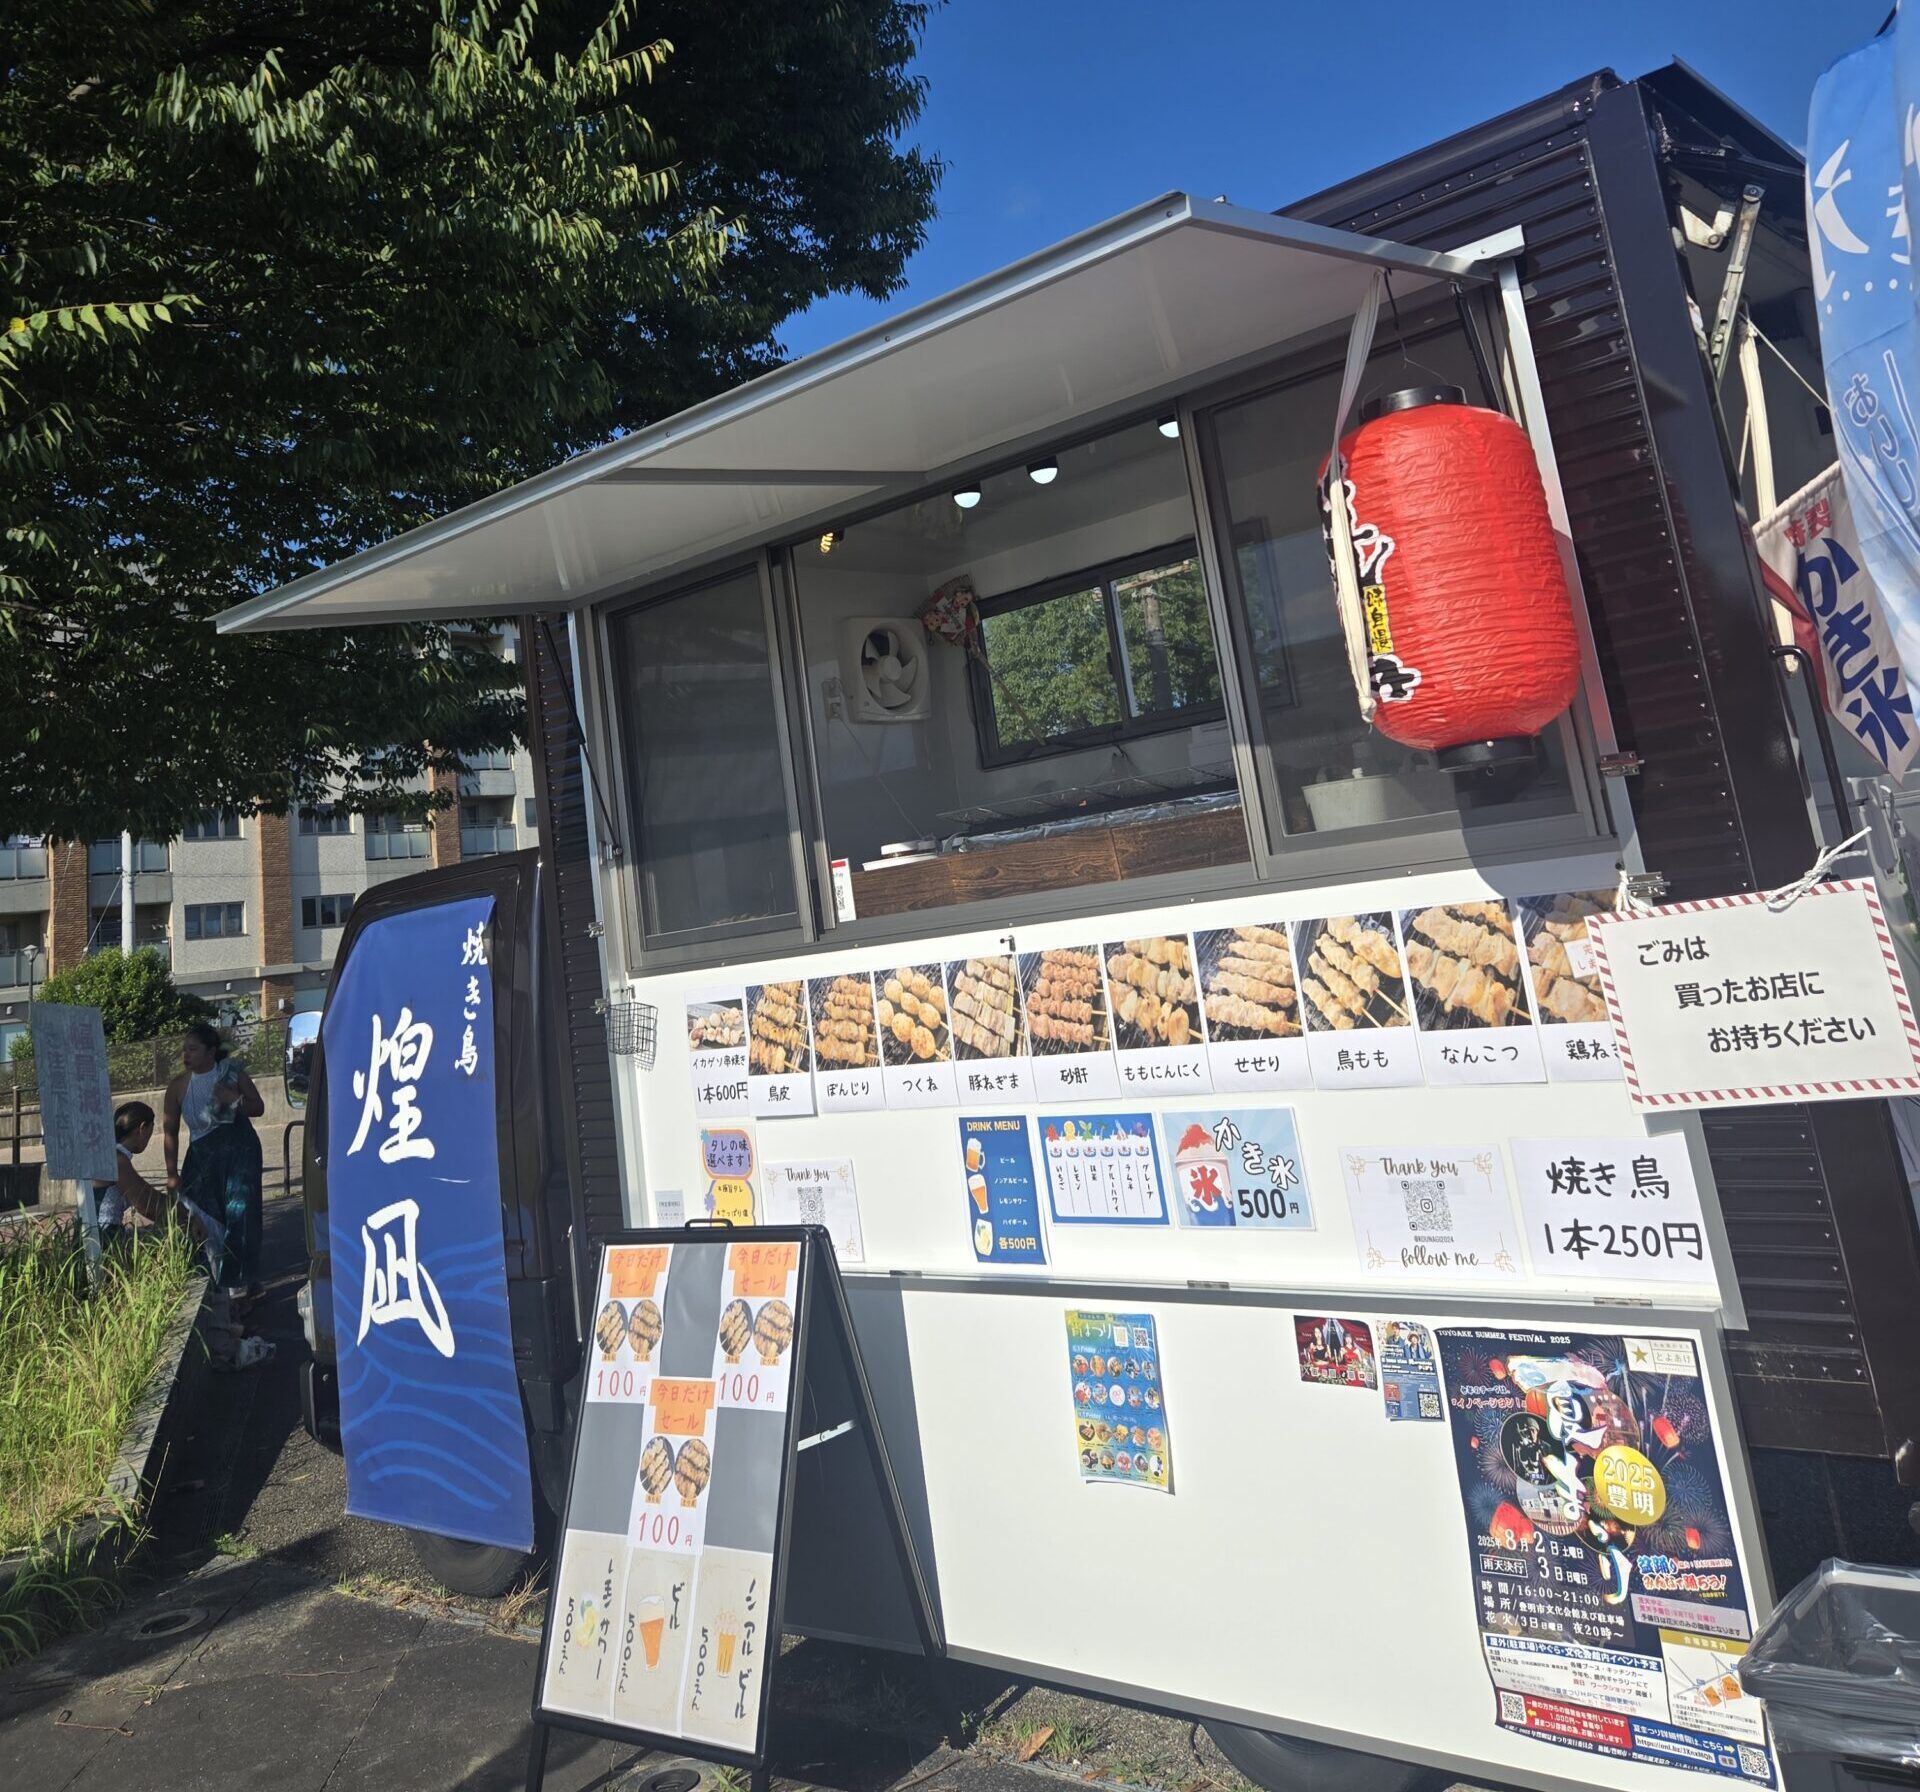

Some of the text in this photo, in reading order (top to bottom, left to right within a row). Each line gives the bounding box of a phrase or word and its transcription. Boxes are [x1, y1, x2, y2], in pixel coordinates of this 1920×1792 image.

[1798, 537, 1913, 770] かき氷
[1637, 936, 1710, 966] ごみは
[455, 920, 488, 1076] 焼き鳥
[1675, 971, 1825, 1009] 買ったお店に
[1707, 1017, 1876, 1053] お持ちください
[693, 1055, 745, 1069] イカゲソ串焼き
[1337, 1048, 1389, 1071] 鳥もも
[1441, 1045, 1519, 1064] なんこつ
[1124, 1062, 1200, 1081] ももにんにく
[1234, 1055, 1280, 1074] せせり
[903, 1076, 938, 1092] つくね
[969, 1072, 1019, 1091] 豚ねぎま
[1060, 1067, 1089, 1085] 砂肝
[698, 1081, 748, 1104] 1本600円
[768, 1085, 791, 1102] 鳥皮
[967, 1120, 1021, 1132] DRINK MENU
[711, 1139, 748, 1152] タレの味
[1213, 1117, 1299, 1190] かき氷
[785, 1167, 812, 1181] Thank
[1379, 1157, 1426, 1176] Thank
[994, 1176, 1028, 1184] ノンアルビール
[1056, 1166, 1064, 1190] いちご
[1073, 1165, 1081, 1190] レモン
[1125, 1164, 1133, 1190] ラムネ
[1190, 1165, 1223, 1206] 氷
[1546, 1155, 1669, 1199] 焼き鳥
[999, 1197, 1027, 1205] レモンサワー
[1238, 1188, 1299, 1219] 500円
[999, 1237, 1037, 1250] 各500円
[1545, 1218, 1703, 1260] 1本250円
[613, 1251, 663, 1270] 今日だけ
[737, 1248, 792, 1266] 今日だけ
[1401, 1245, 1479, 1268] follow me
[615, 1277, 651, 1293] セール
[740, 1274, 780, 1292] セール
[1438, 1330, 1571, 1344] TOYOAKE SUMMER FESTIVAL 2025
[1656, 1351, 1690, 1364] とよあけ
[657, 1383, 711, 1404] 今日だけ
[661, 1412, 699, 1430] セール
[1603, 1457, 1654, 1490] 2025
[1608, 1485, 1654, 1516] 豊明
[1483, 1558, 1524, 1574] 雨天決行
[597, 1558, 613, 1680] レモンサワー
